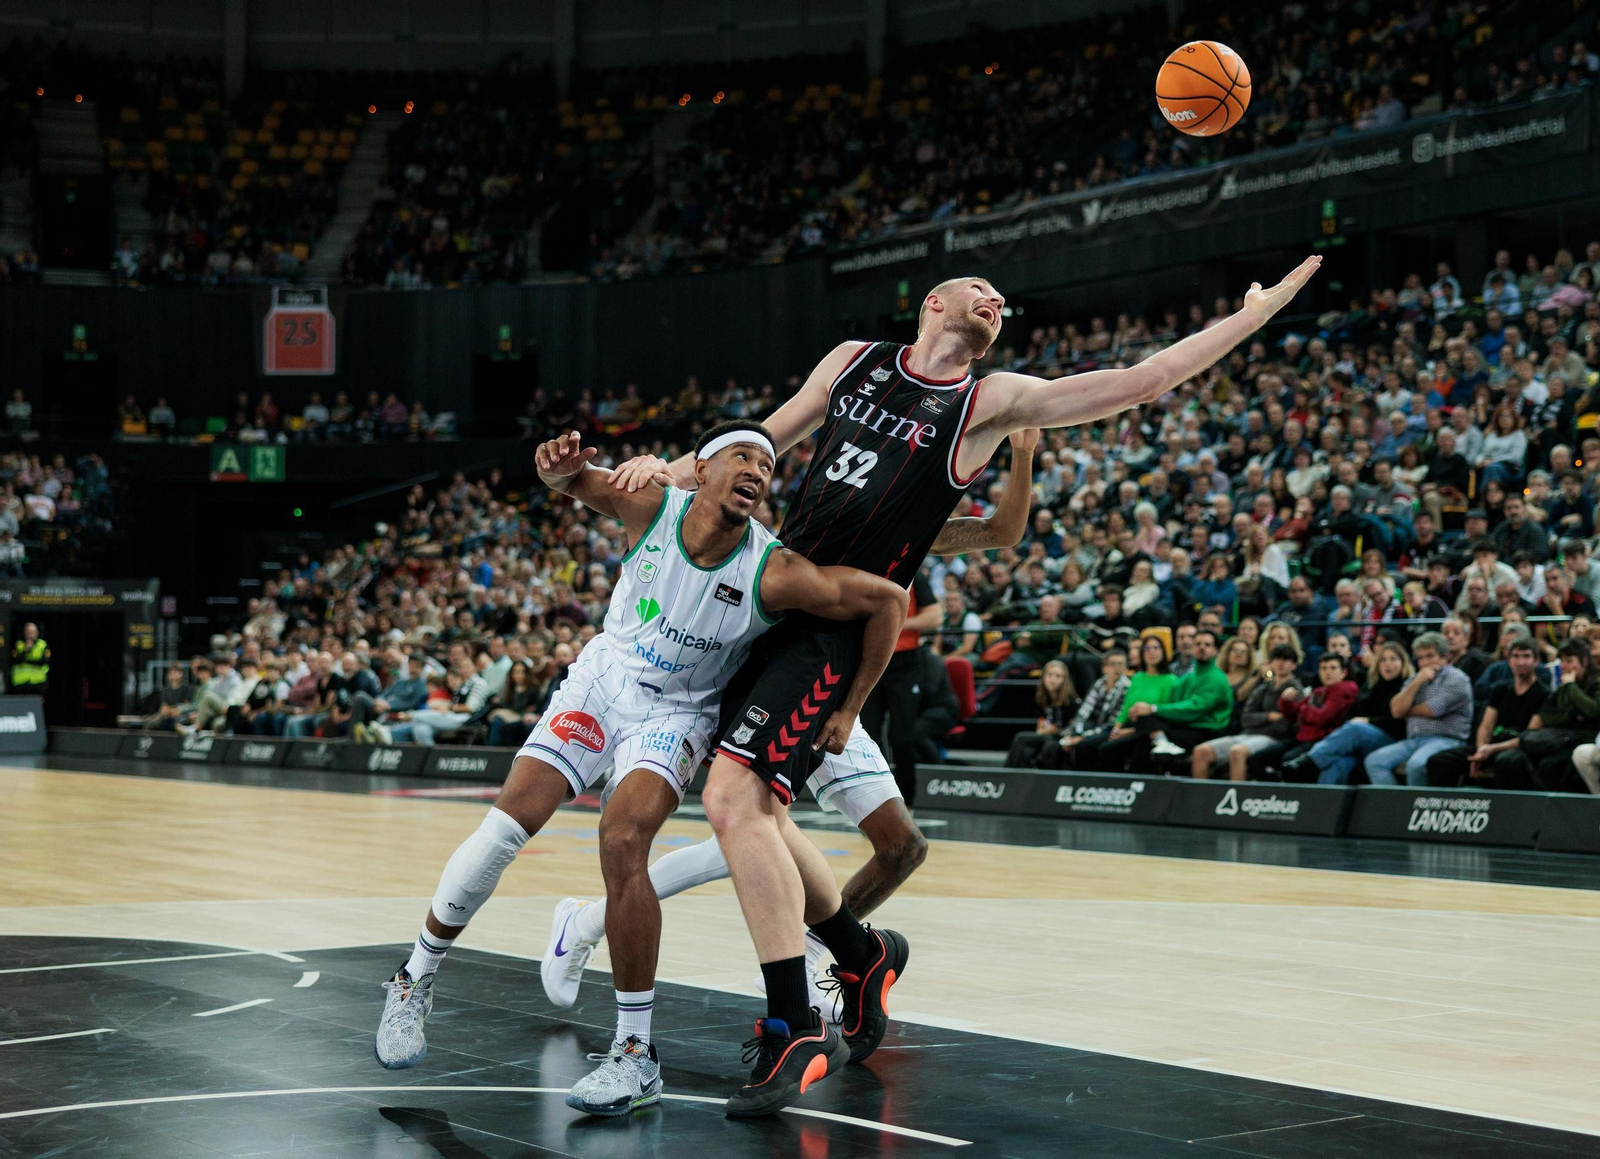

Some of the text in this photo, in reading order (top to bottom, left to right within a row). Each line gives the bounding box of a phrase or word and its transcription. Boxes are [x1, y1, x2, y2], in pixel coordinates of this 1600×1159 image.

[283, 318, 318, 346] 25
[834, 395, 937, 447] surne
[218, 447, 241, 473] A
[825, 441, 879, 489] 32
[659, 616, 723, 653] Unicaja
[750, 711, 761, 721] acb
[436, 757, 488, 772] NISSAN
[1055, 785, 1074, 803] EL
[1074, 786, 1137, 807] CORREO
[1407, 808, 1490, 834] LANDAKO
